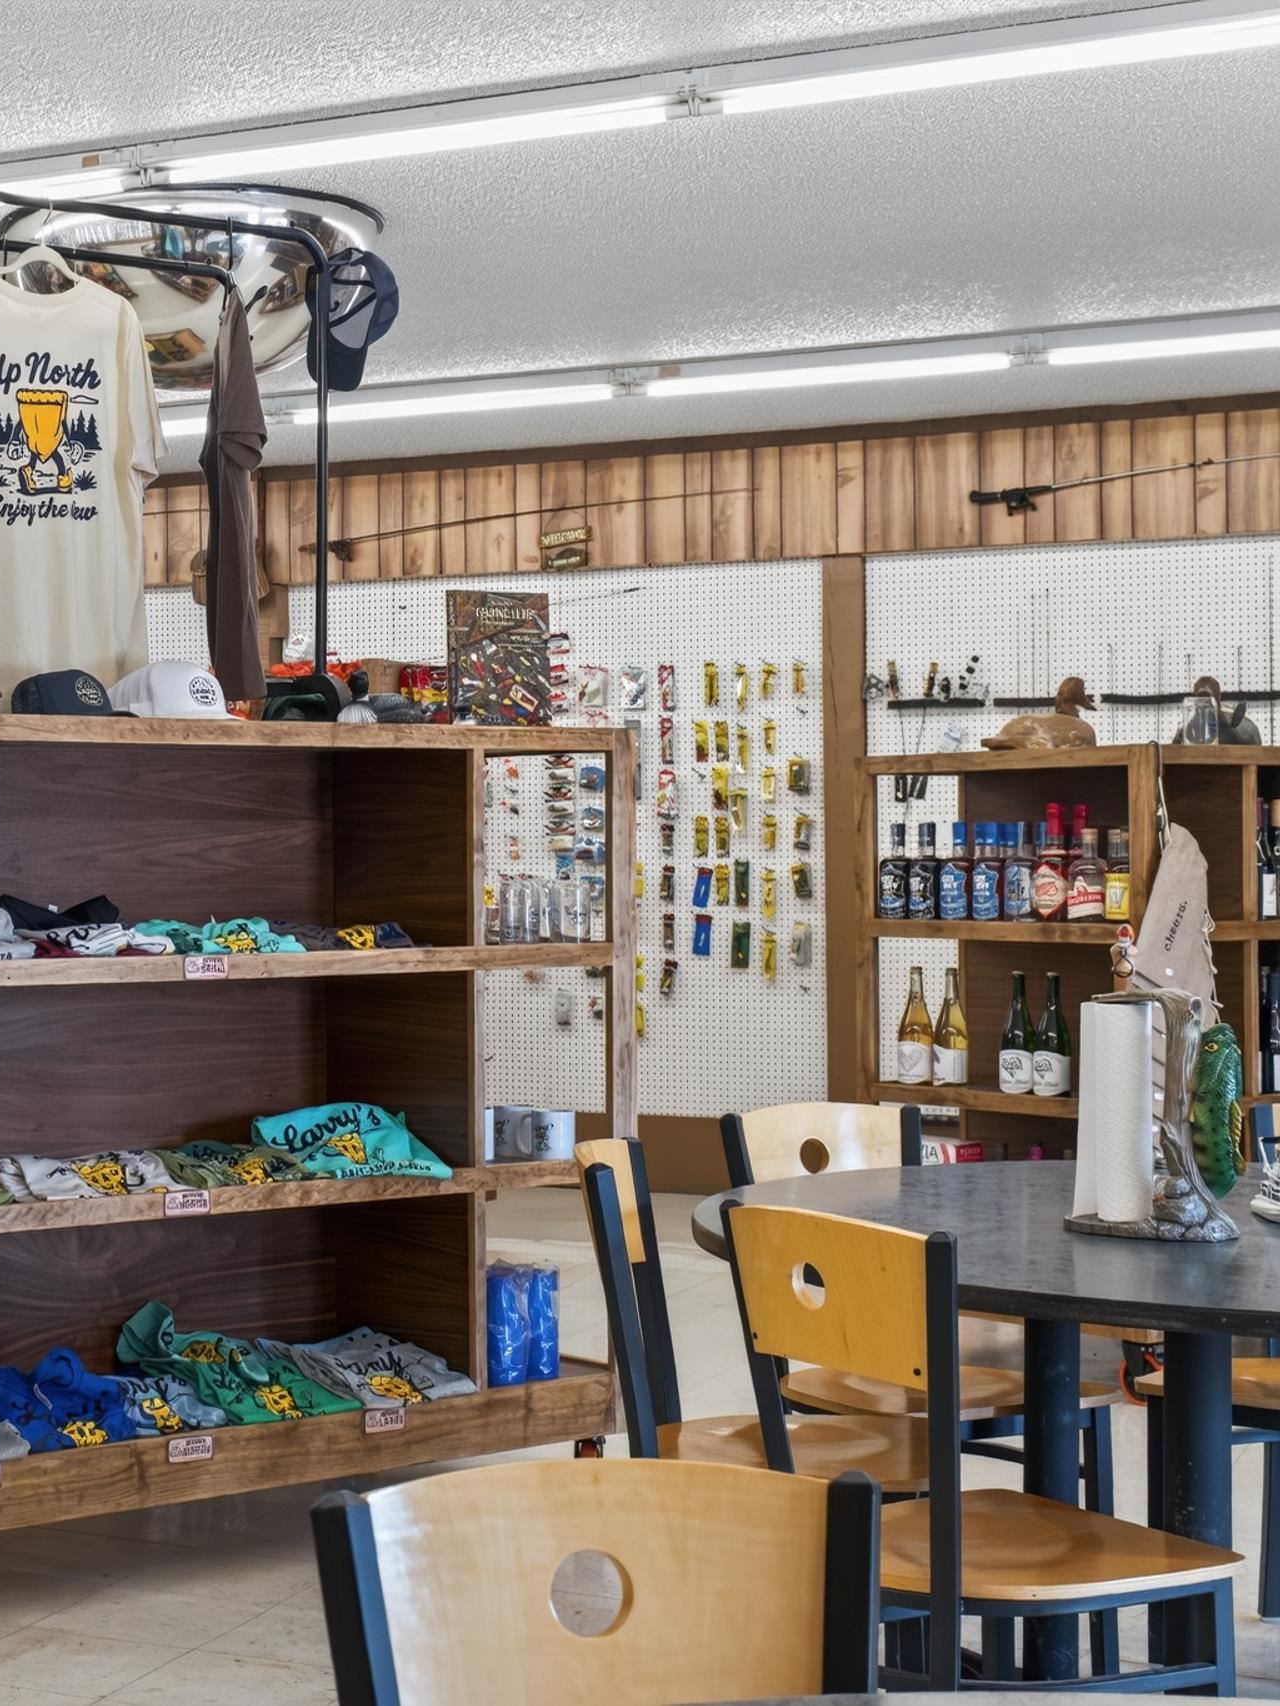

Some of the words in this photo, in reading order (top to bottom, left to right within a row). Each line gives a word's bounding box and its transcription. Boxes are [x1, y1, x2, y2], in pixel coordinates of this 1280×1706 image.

[25, 352, 101, 389] North
[37, 497, 69, 519] the
[271, 1104, 381, 1152] Larry's
